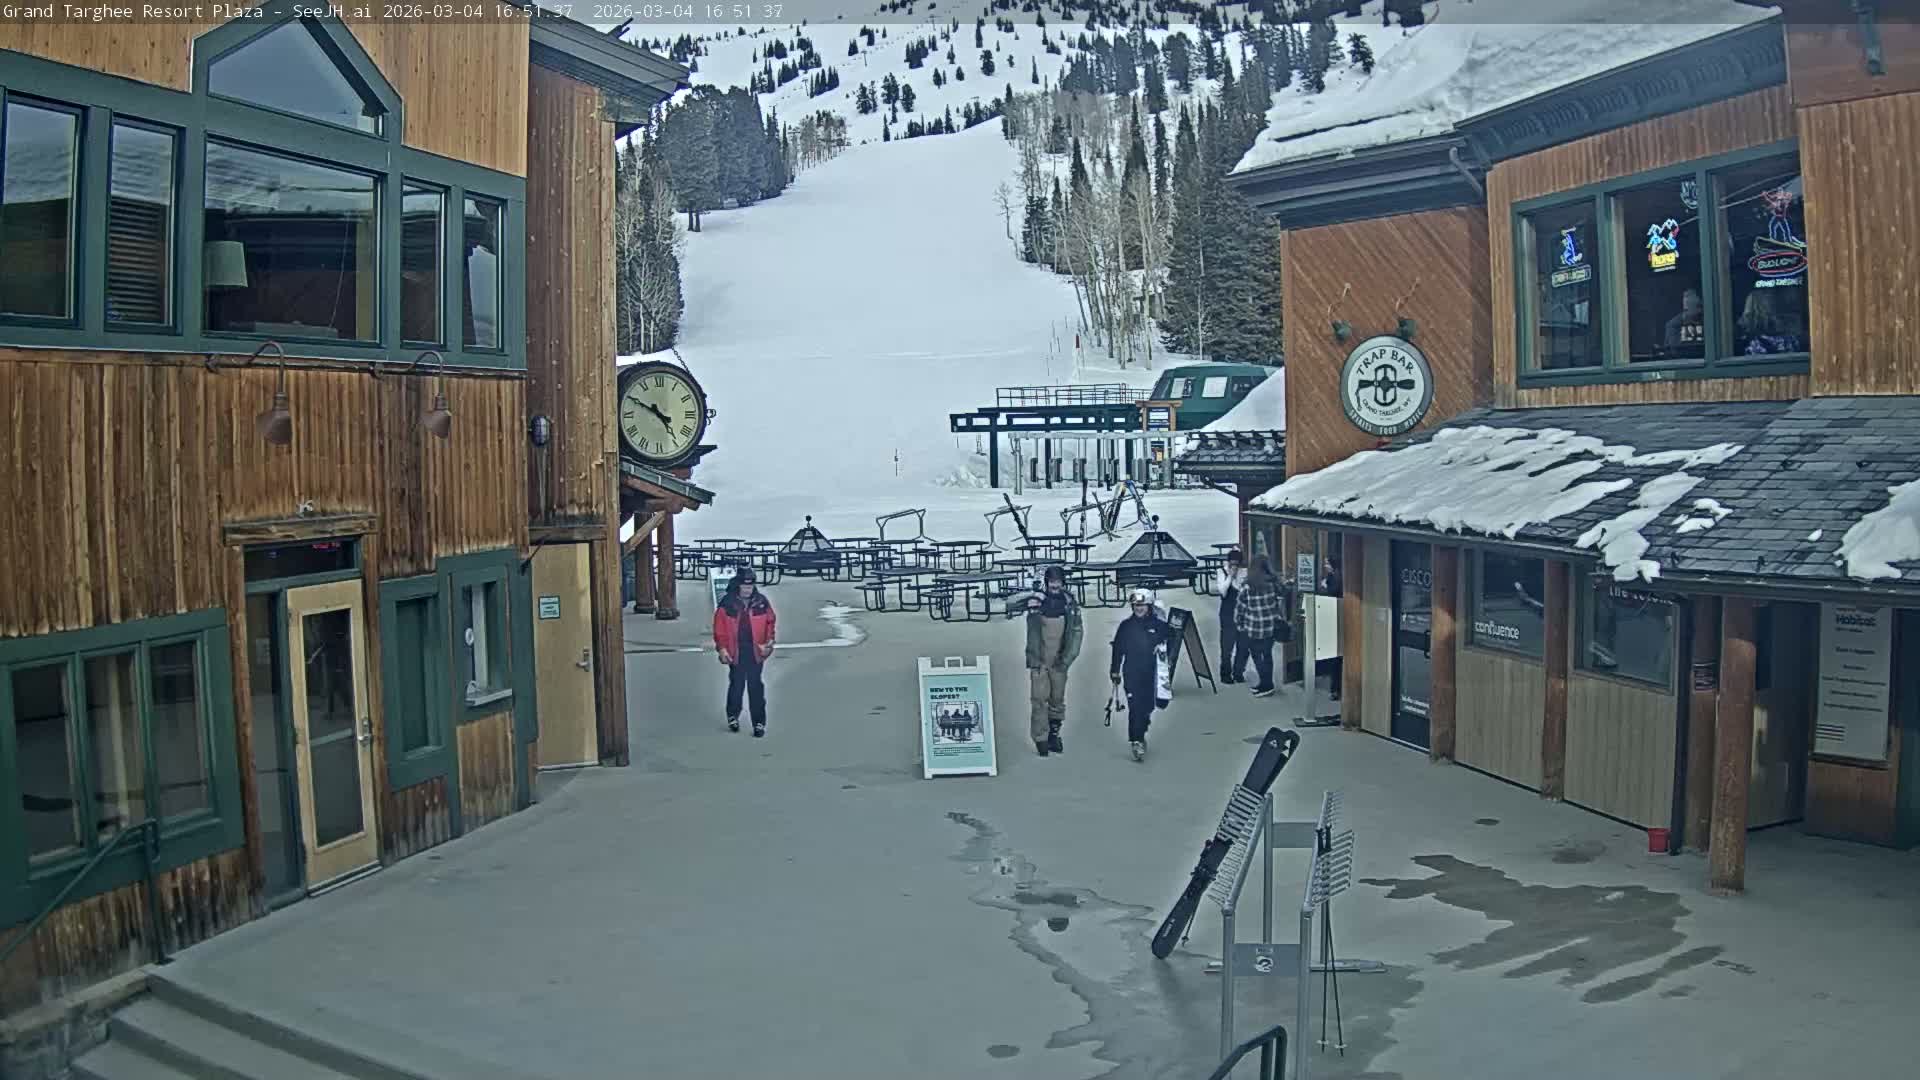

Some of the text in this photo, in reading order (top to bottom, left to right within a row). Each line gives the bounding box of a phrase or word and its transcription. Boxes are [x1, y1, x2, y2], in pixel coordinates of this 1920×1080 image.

[1356, 348, 1414, 375] TRAP BAR
[1474, 620, 1520, 640] confluence
[1835, 614, 1877, 627] Habitat
